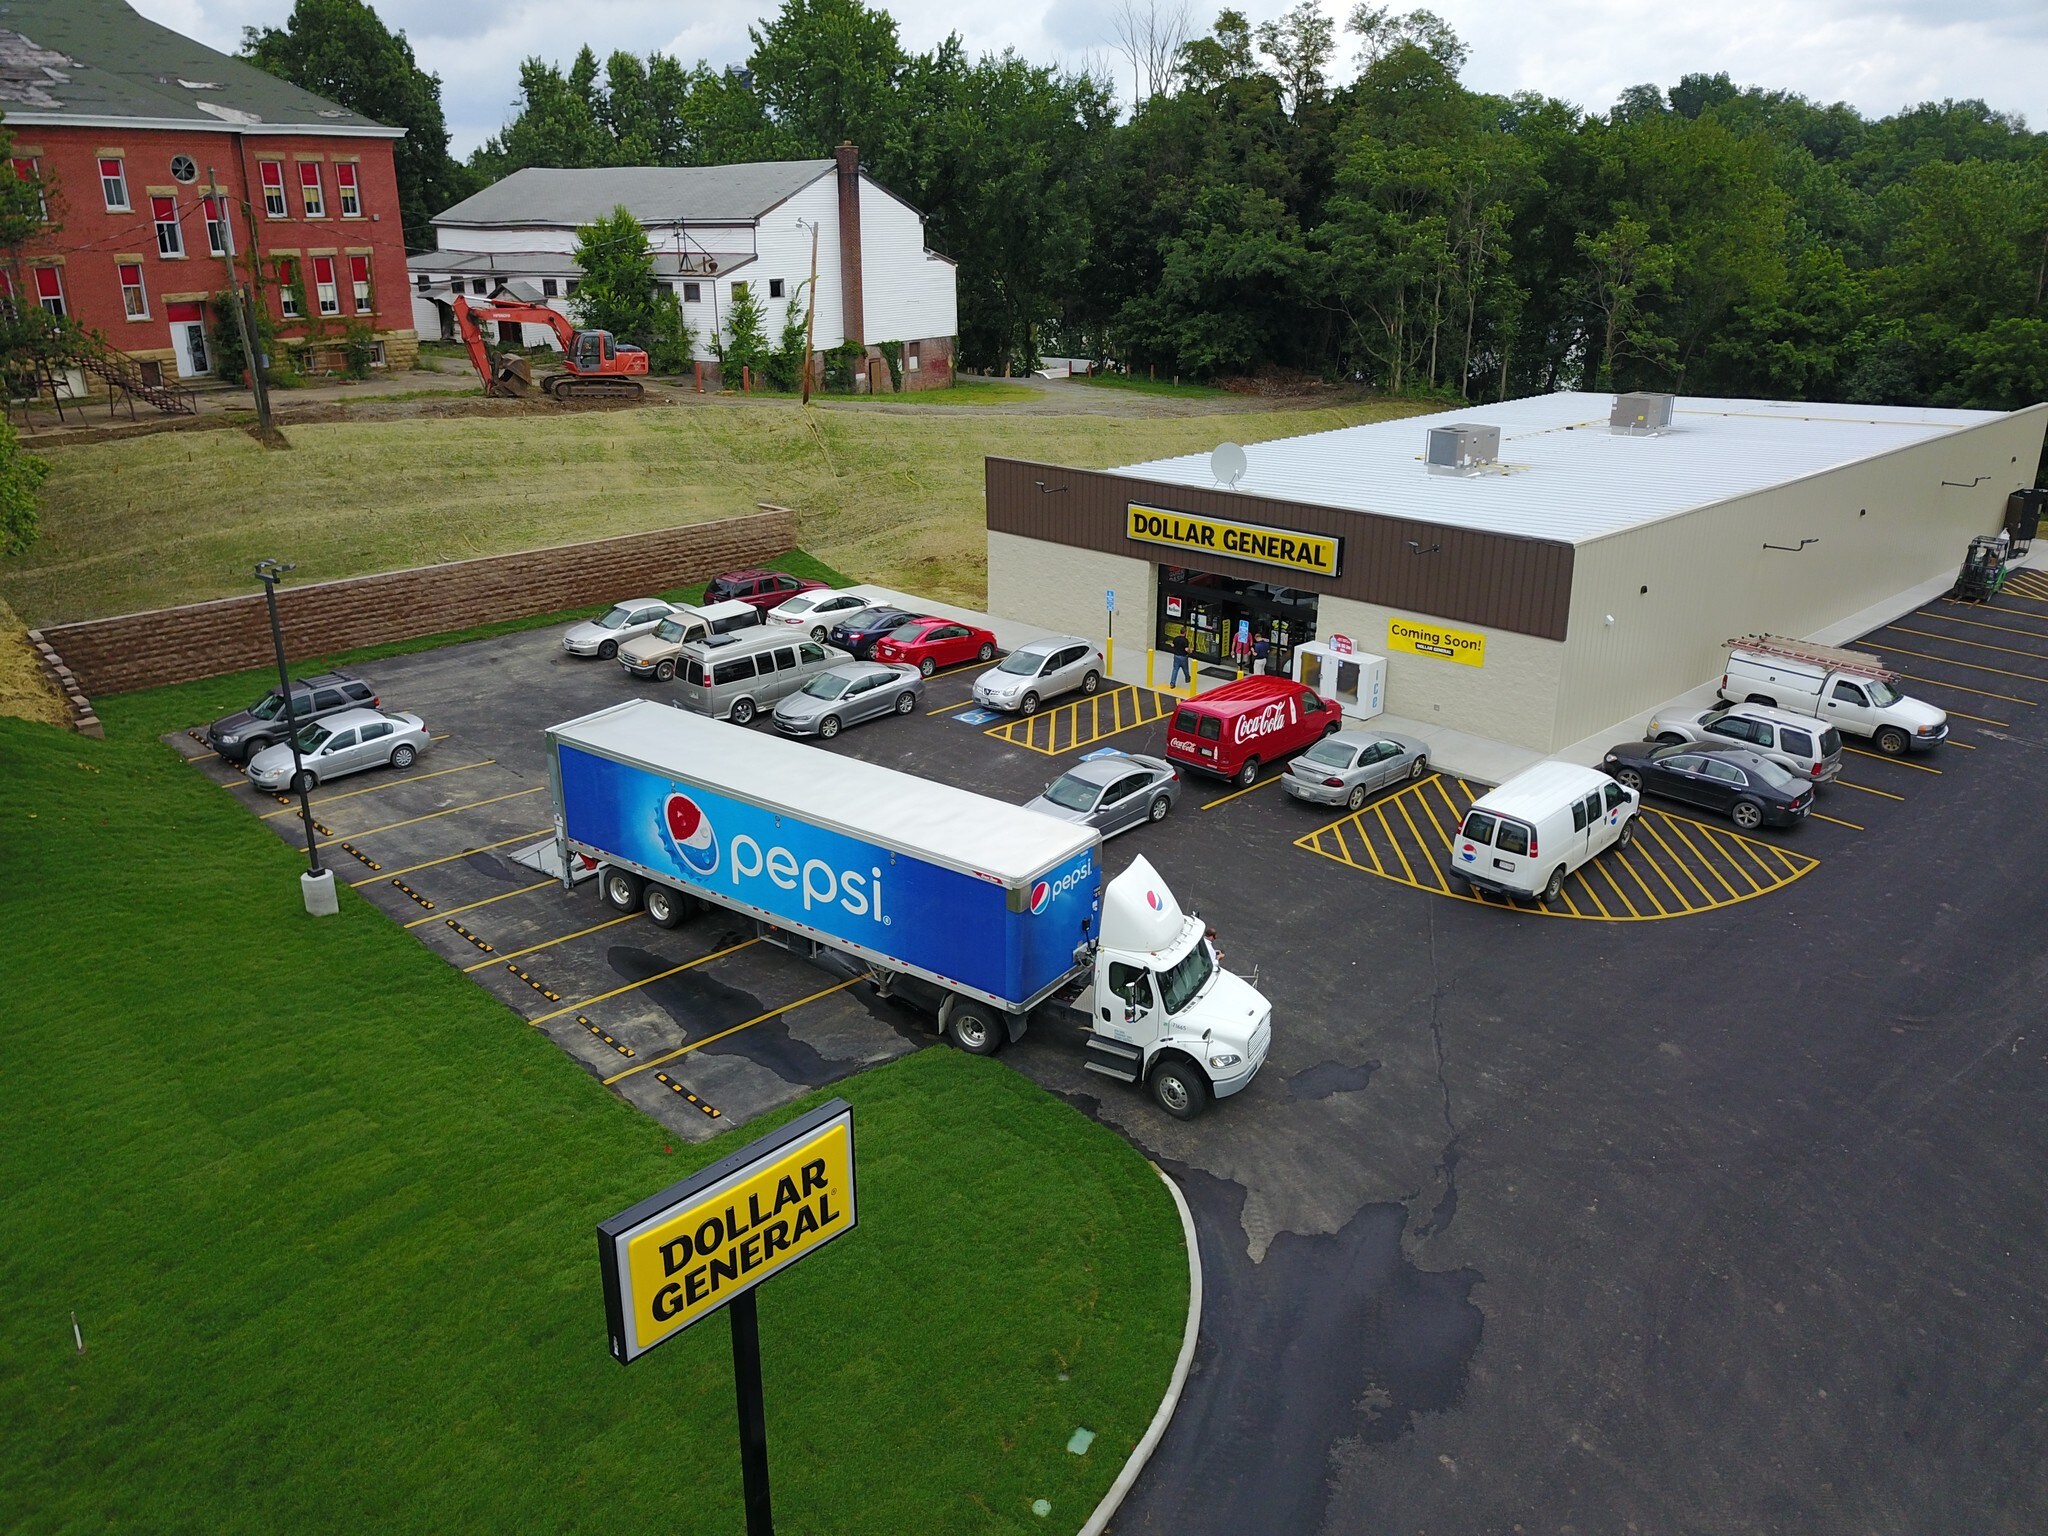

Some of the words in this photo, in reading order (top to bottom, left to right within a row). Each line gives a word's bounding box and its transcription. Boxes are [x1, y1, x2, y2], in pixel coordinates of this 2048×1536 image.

[1133, 513, 1215, 547] DOLLAR
[1223, 529, 1327, 567] GENERAL
[1391, 624, 1440, 645] Coming
[1444, 634, 1482, 651] Soon!
[1170, 737, 1196, 753] Coca-Cola
[1234, 700, 1286, 745] Coca-Cola
[730, 834, 882, 922] pepsi
[1052, 858, 1091, 902] pepsi
[658, 1157, 829, 1278] DOLLAR
[651, 1194, 840, 1322] GENERAL
